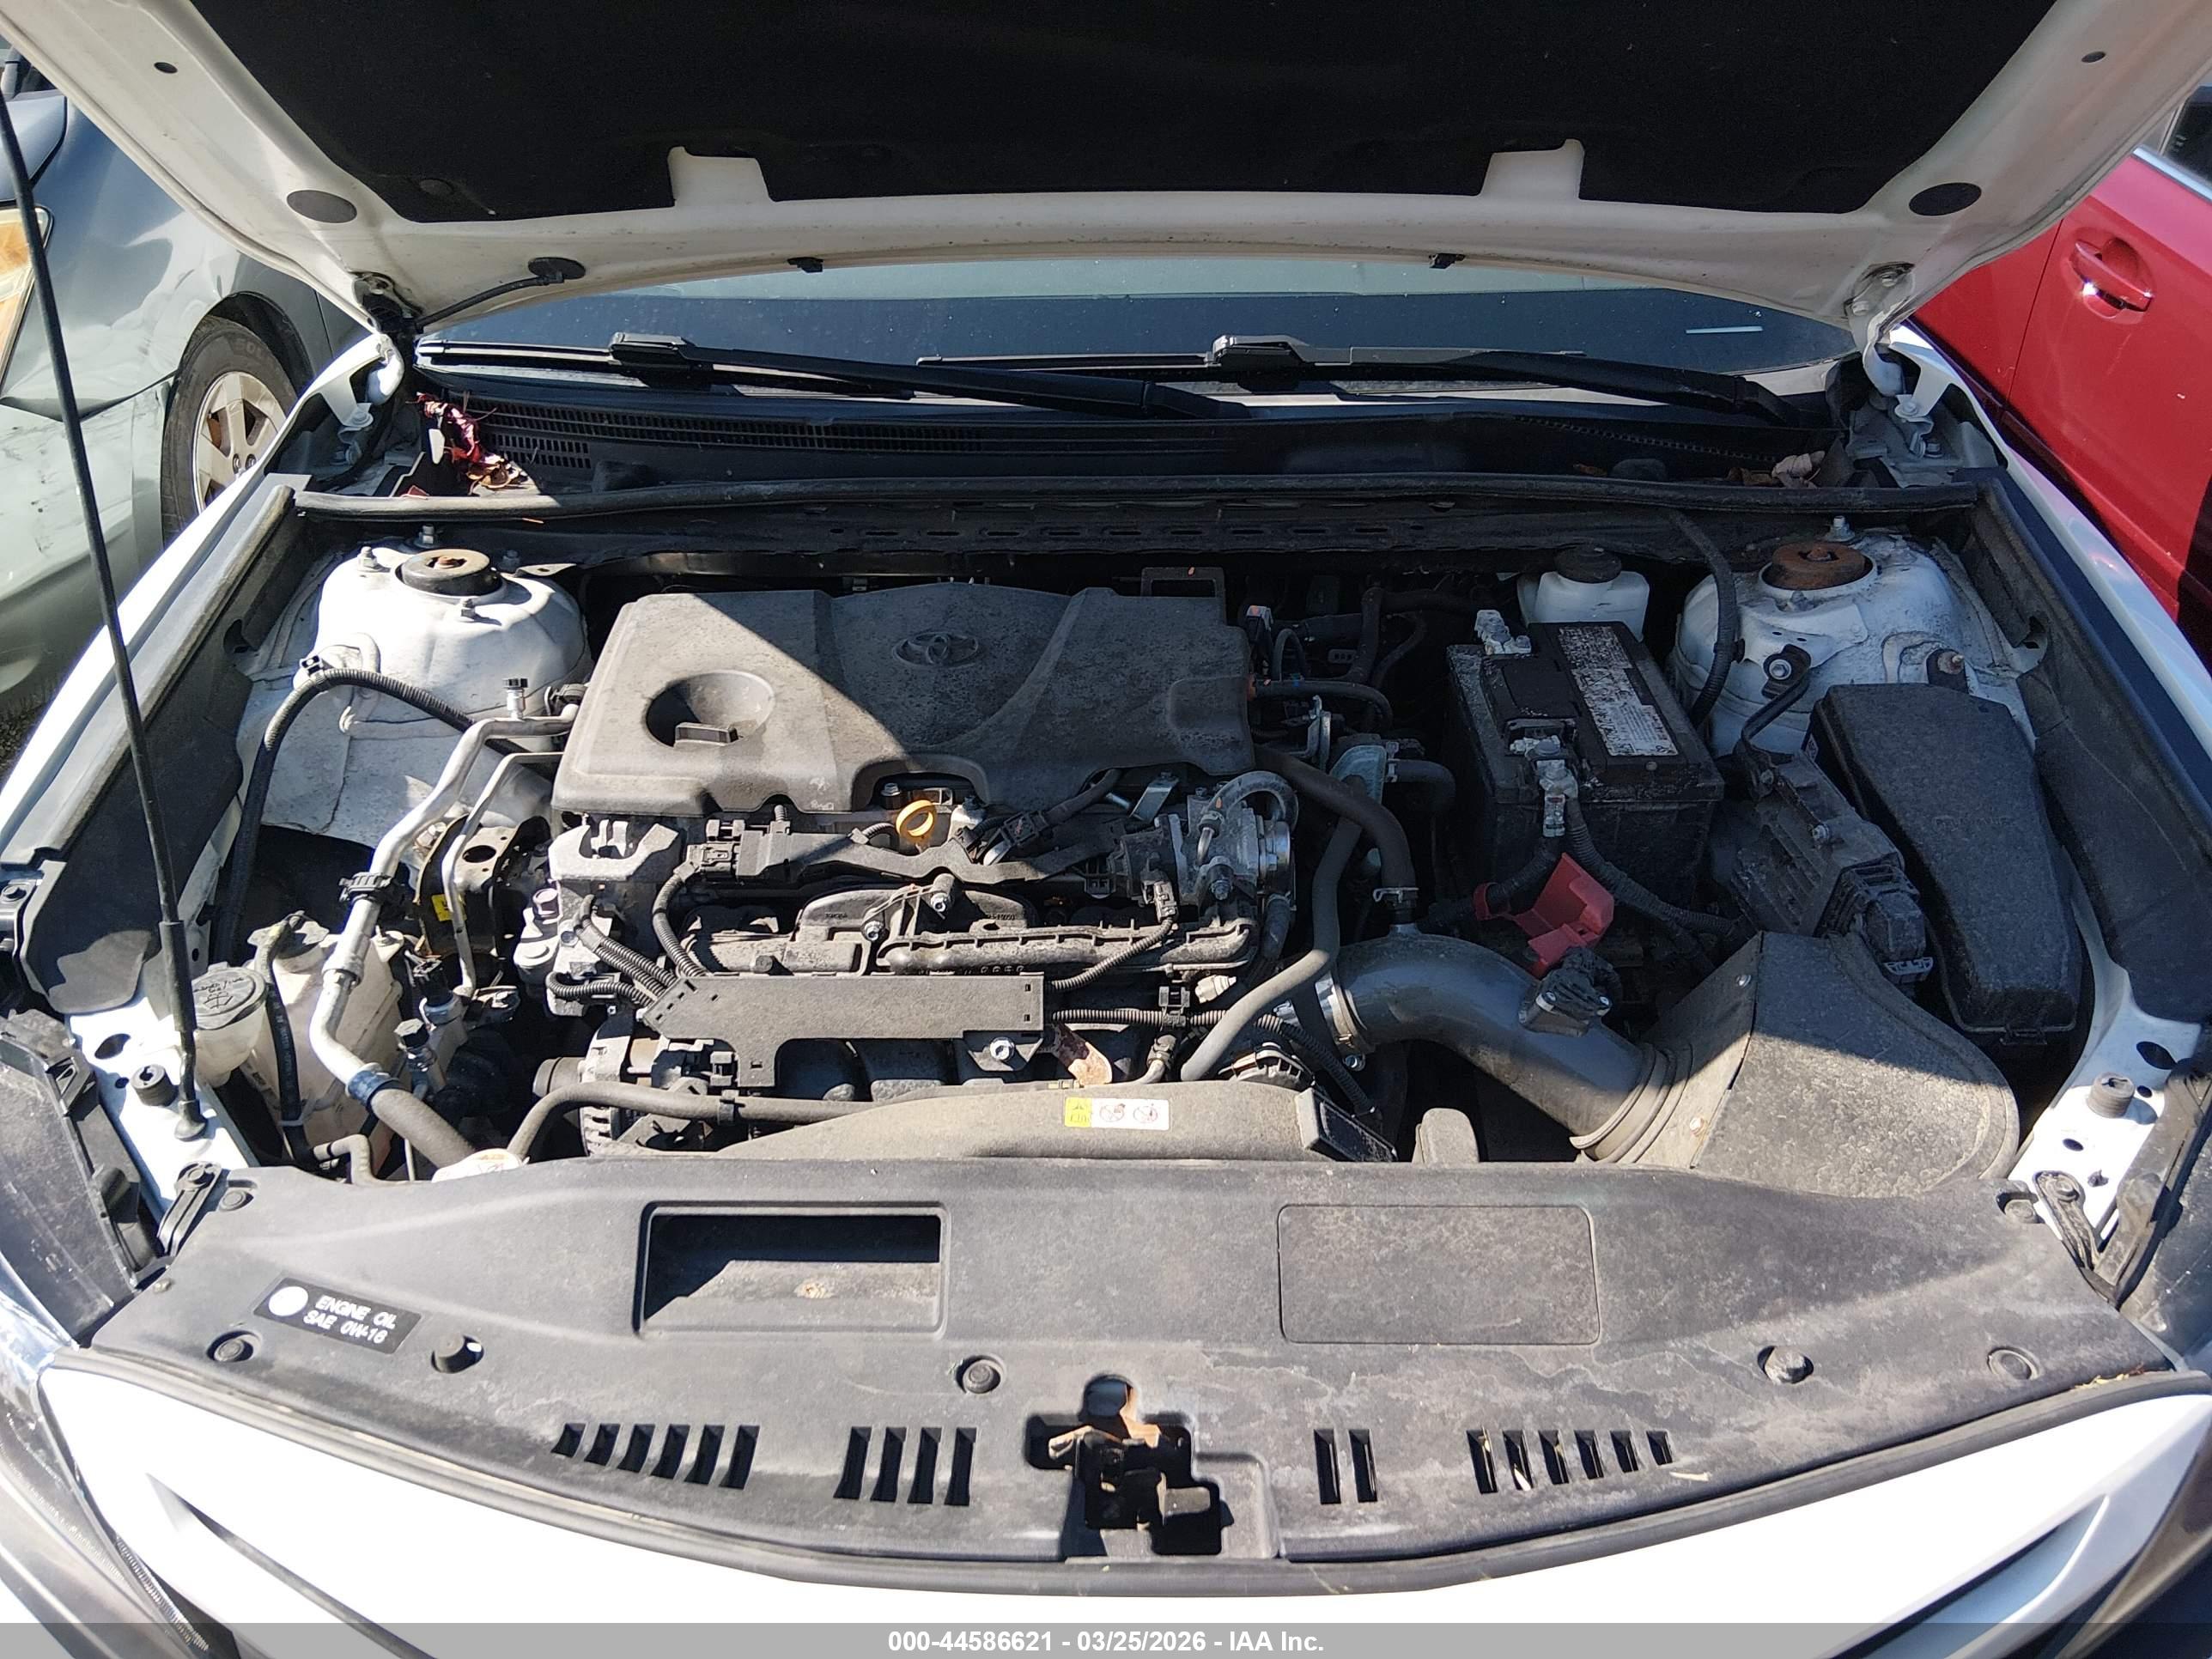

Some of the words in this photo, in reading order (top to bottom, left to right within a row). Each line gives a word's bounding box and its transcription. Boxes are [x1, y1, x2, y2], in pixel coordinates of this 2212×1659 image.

[303, 1310, 337, 1330] SAE
[341, 1321, 388, 1344] 0W-16
[315, 1295, 371, 1320] ENGINE
[374, 1312, 397, 1329] OIL
